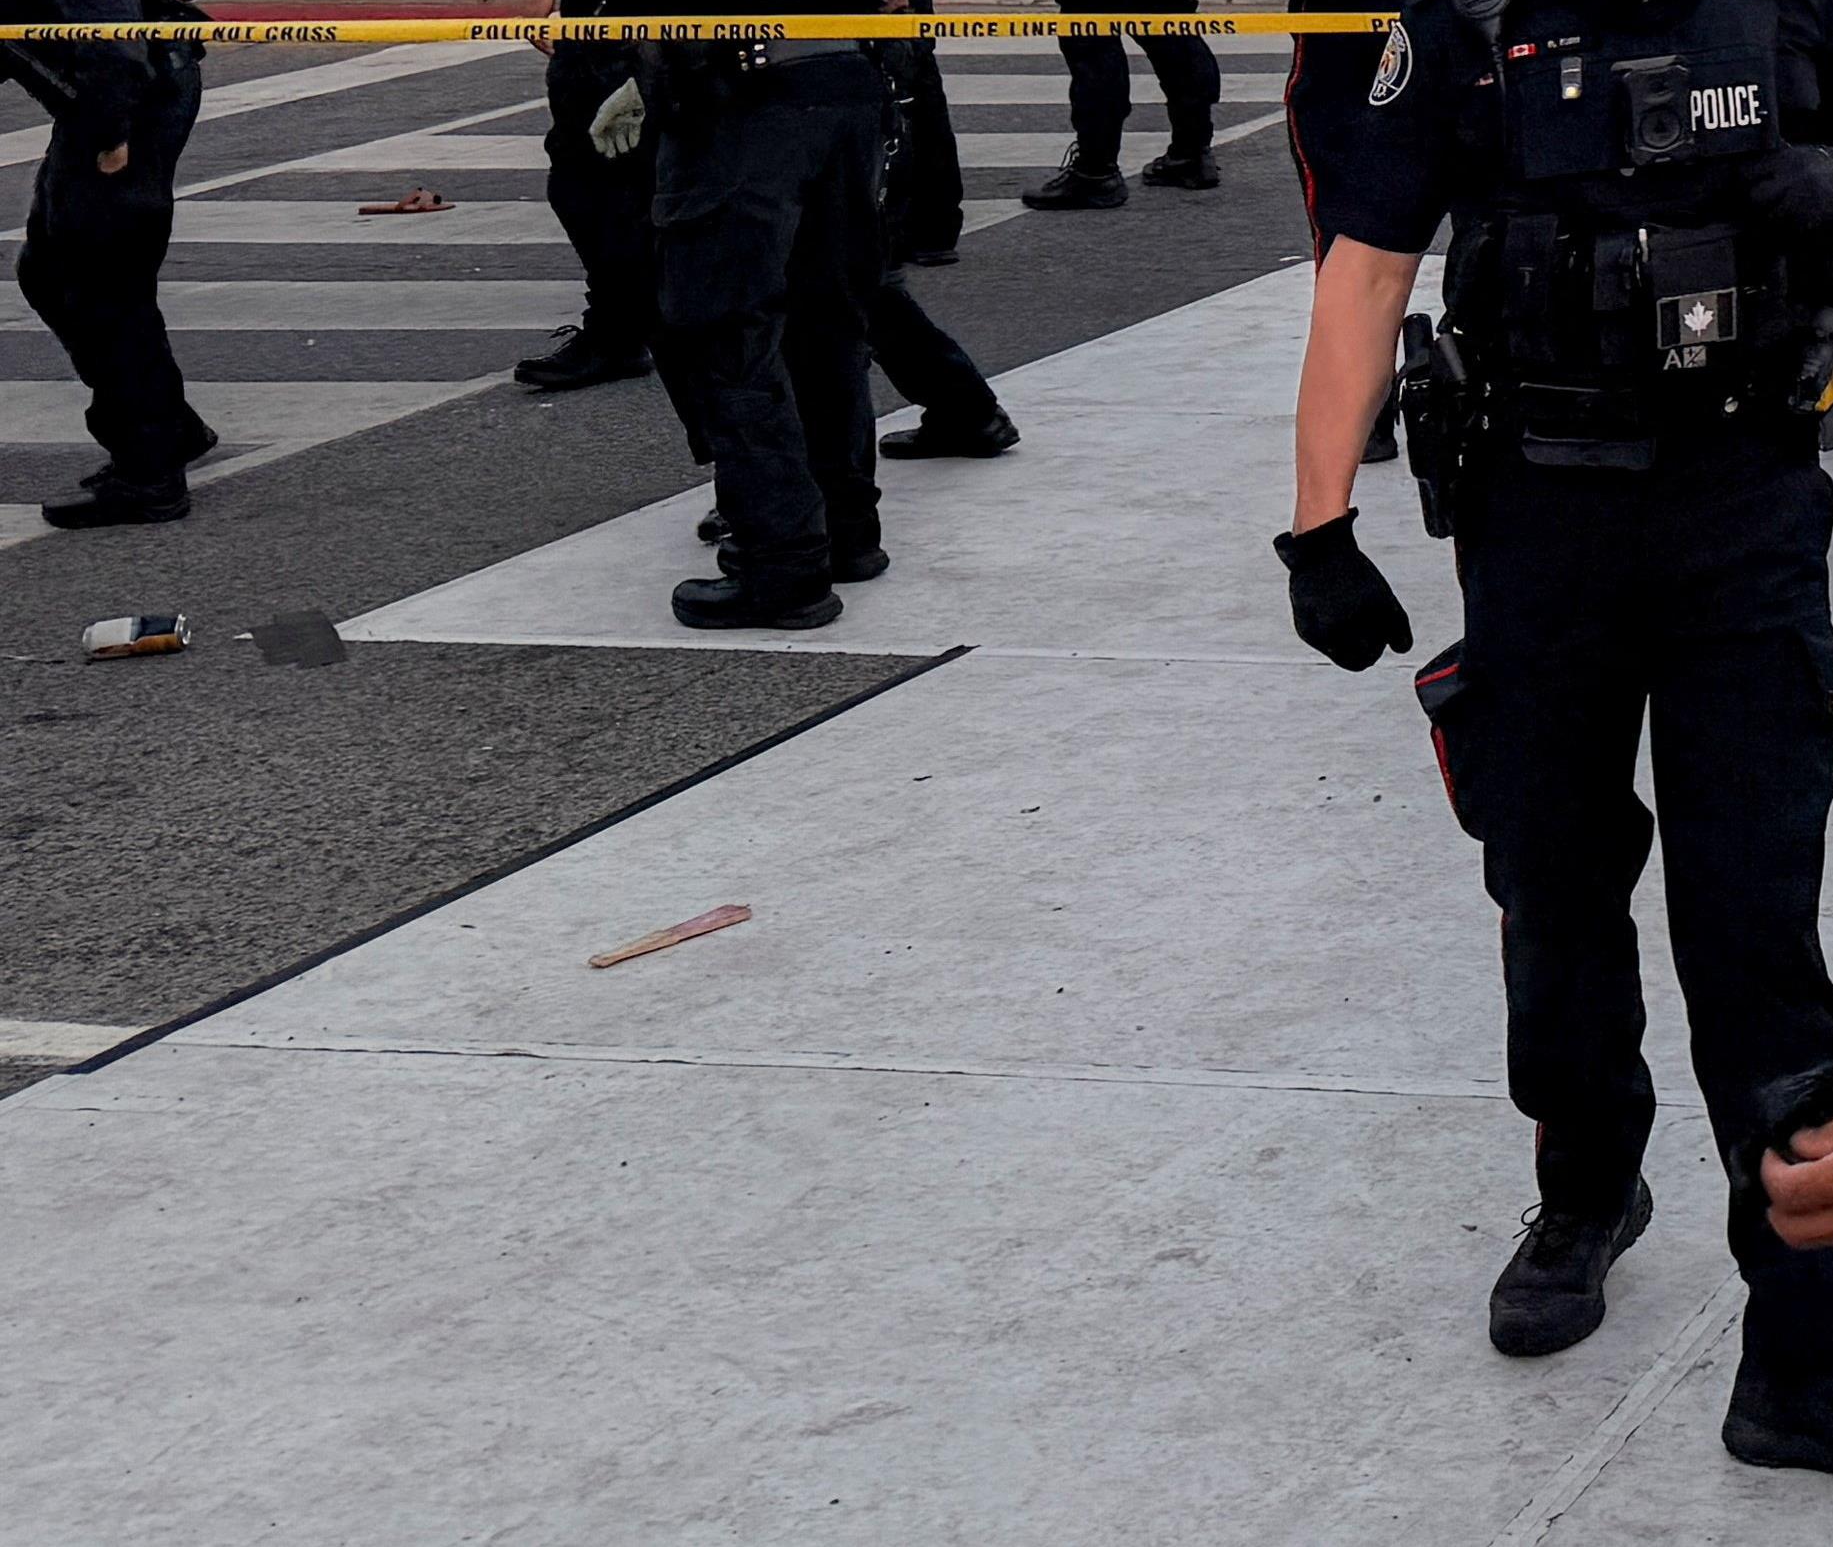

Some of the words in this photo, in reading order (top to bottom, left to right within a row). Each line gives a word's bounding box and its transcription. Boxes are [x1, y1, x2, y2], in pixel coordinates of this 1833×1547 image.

[470, 24, 550, 40] POLICE
[560, 24, 602, 40] LINE
[621, 24, 646, 40] DO
[660, 24, 702, 39] NOT
[713, 23, 785, 40] CROSS
[919, 22, 998, 39] POLICE
[1009, 22, 1057, 38] LINE
[1070, 21, 1098, 35] DO
[1112, 20, 1152, 35] NOT
[1162, 20, 1236, 35] CROSS
[1690, 84, 1761, 131] POLICE
